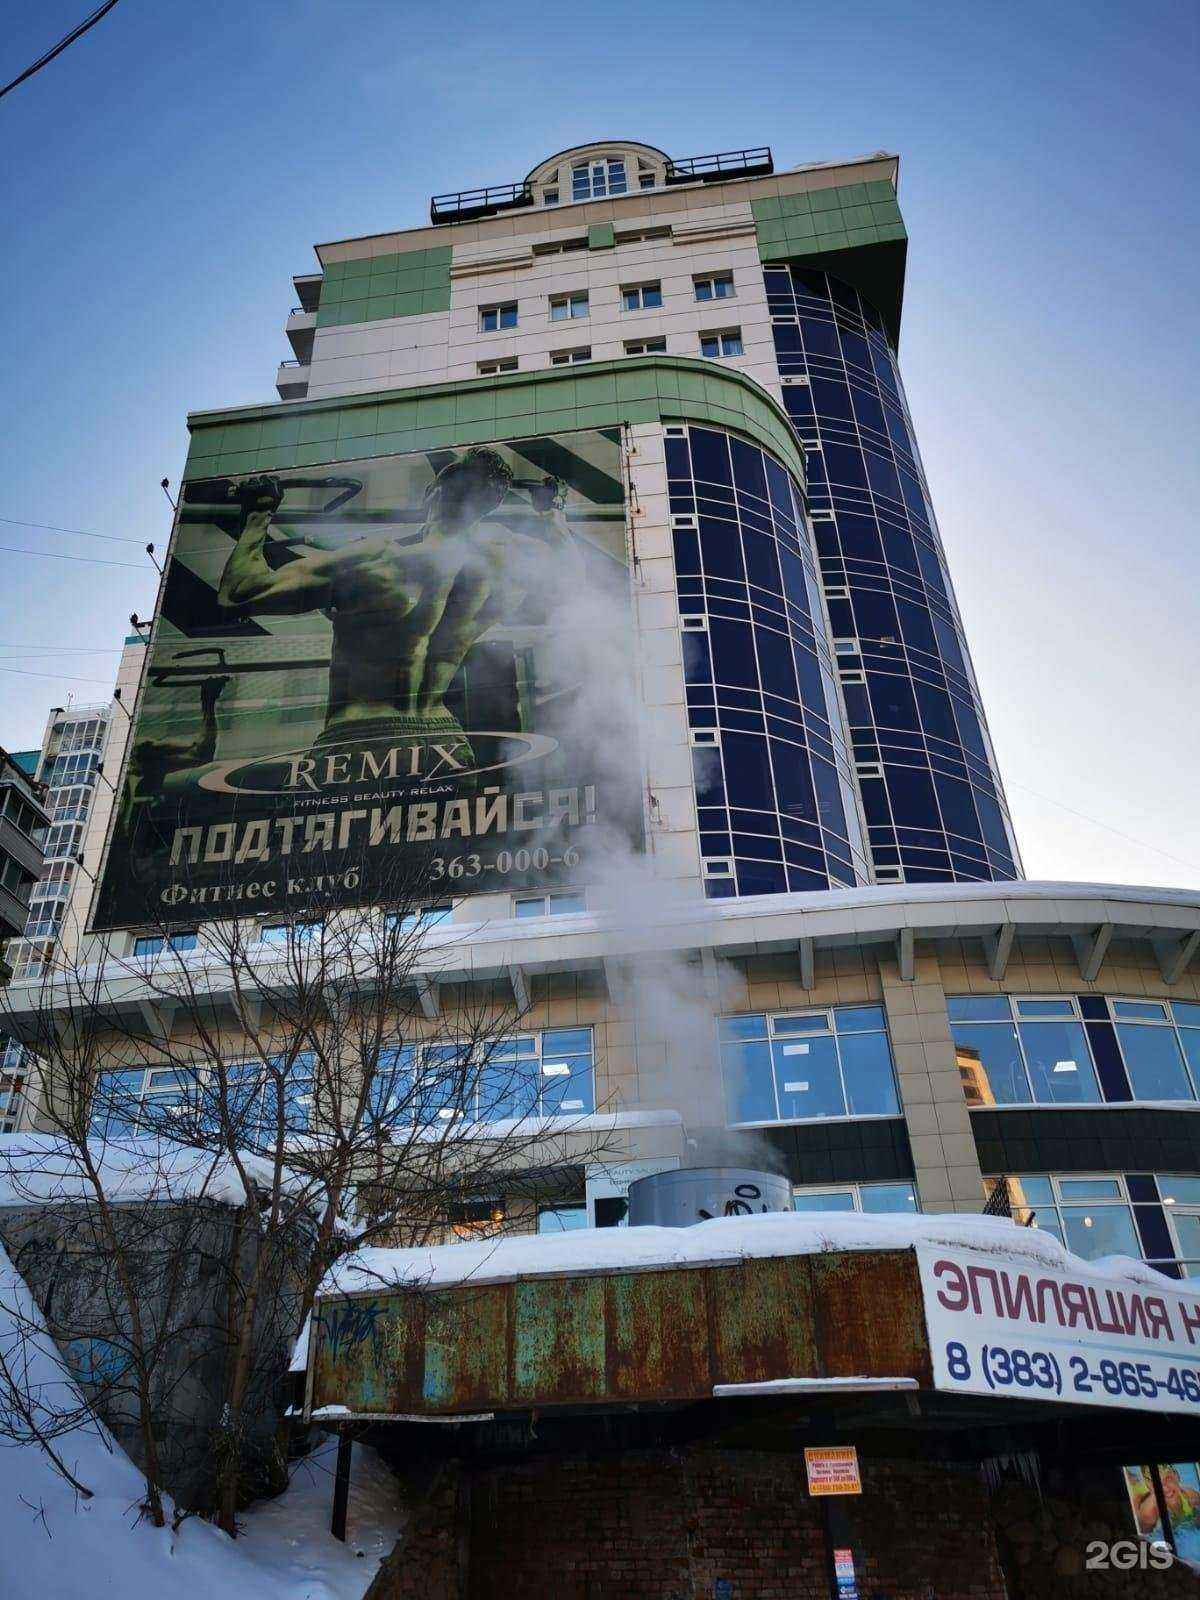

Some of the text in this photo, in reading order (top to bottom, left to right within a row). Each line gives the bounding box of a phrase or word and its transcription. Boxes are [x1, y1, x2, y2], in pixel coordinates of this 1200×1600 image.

[287, 743, 468, 793] REMIX
[294, 784, 453, 808] FITNESS BEAUTY RELAX
[168, 784, 597, 866] ПОДТЯГИВАЙСЯ!
[160, 865, 360, 906] Фитнес клуб
[933, 1260, 1175, 1342] ЭПИЛЯЦИЯ
[946, 1341, 1200, 1403] 8 (383) 2-865-46
